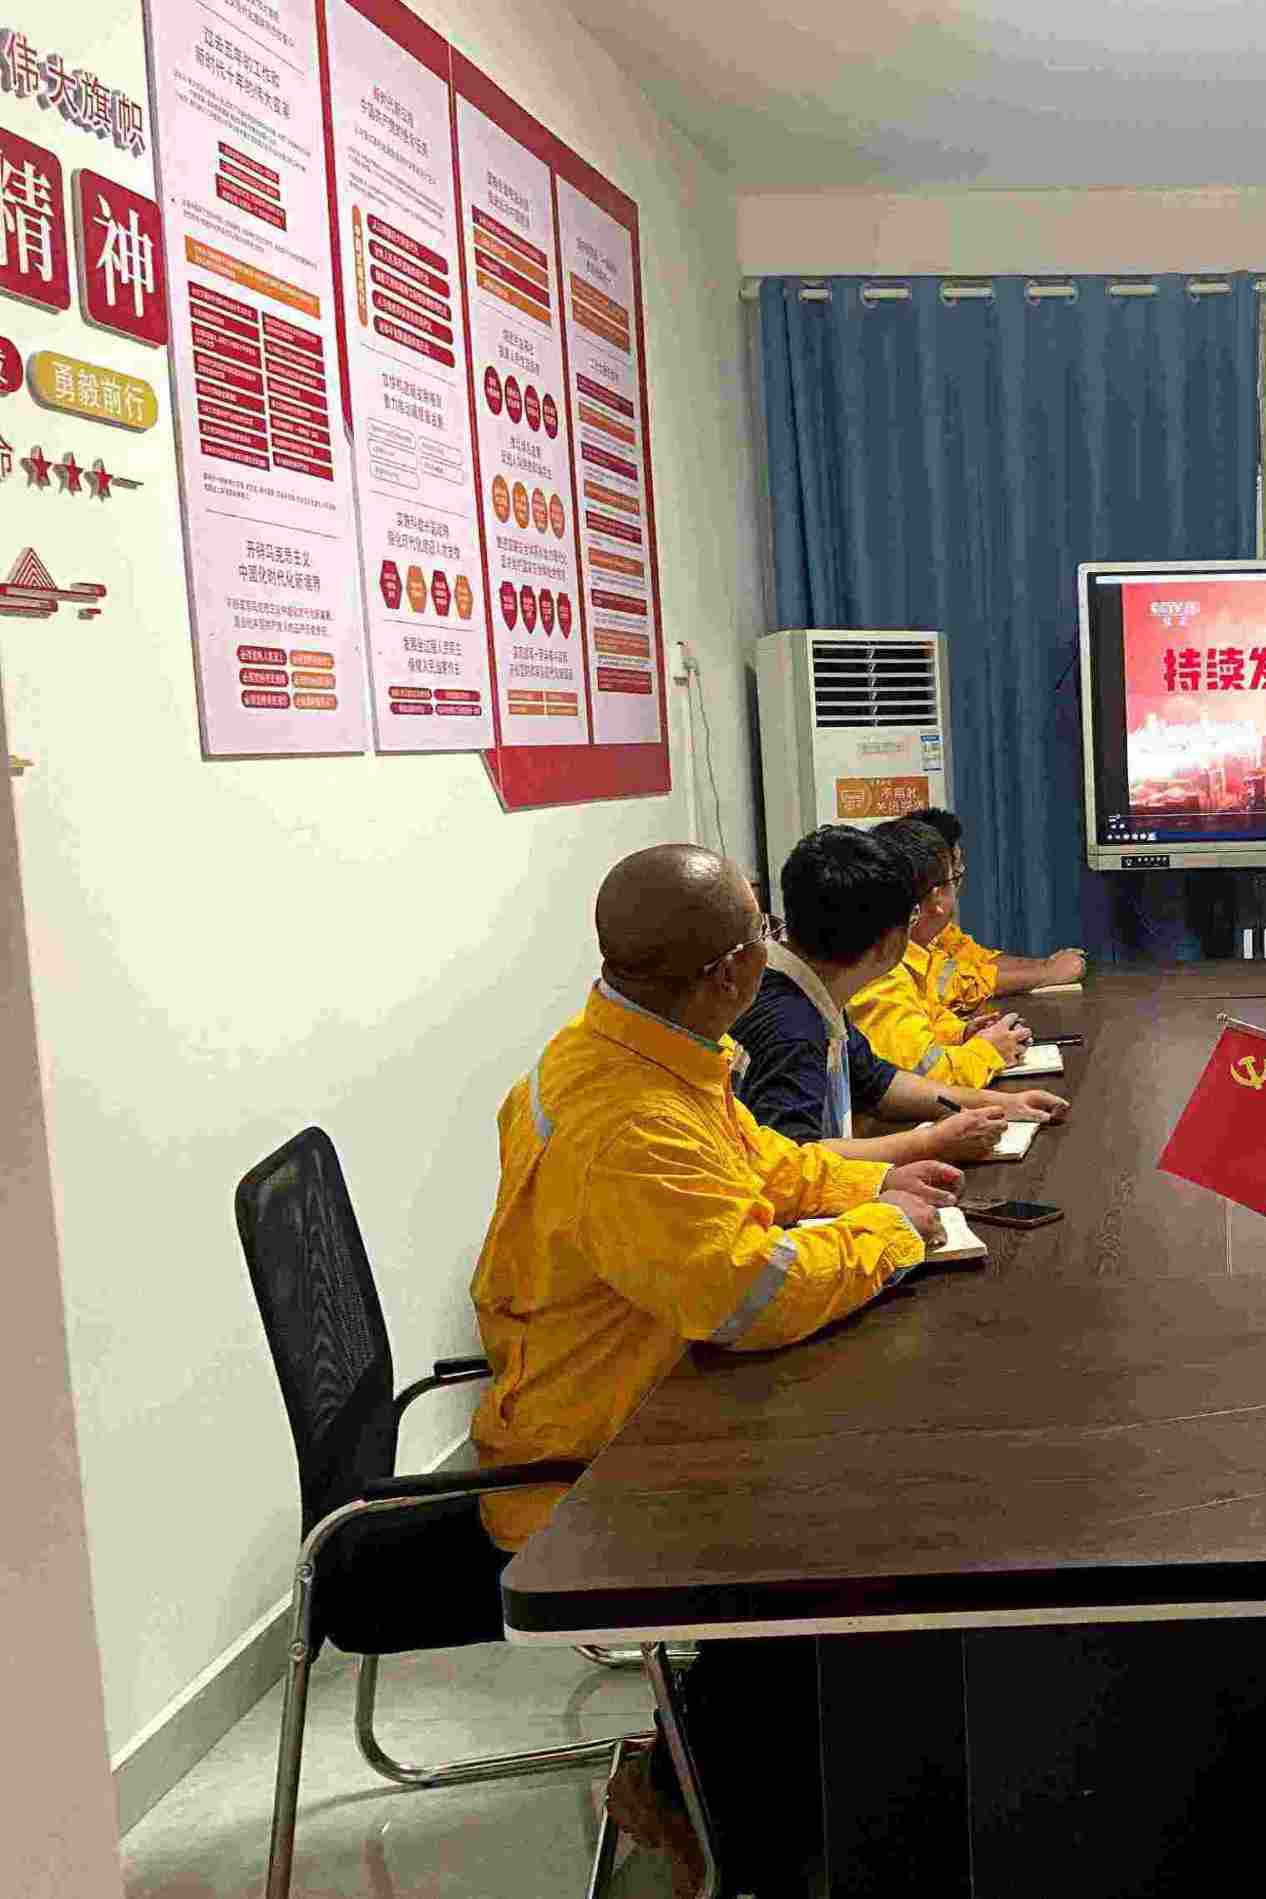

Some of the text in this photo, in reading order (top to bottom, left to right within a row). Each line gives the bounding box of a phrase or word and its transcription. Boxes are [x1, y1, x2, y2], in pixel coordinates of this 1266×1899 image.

[5, 30, 147, 152] 伟大旗帜
[51, 360, 146, 423] 勇毅前行
